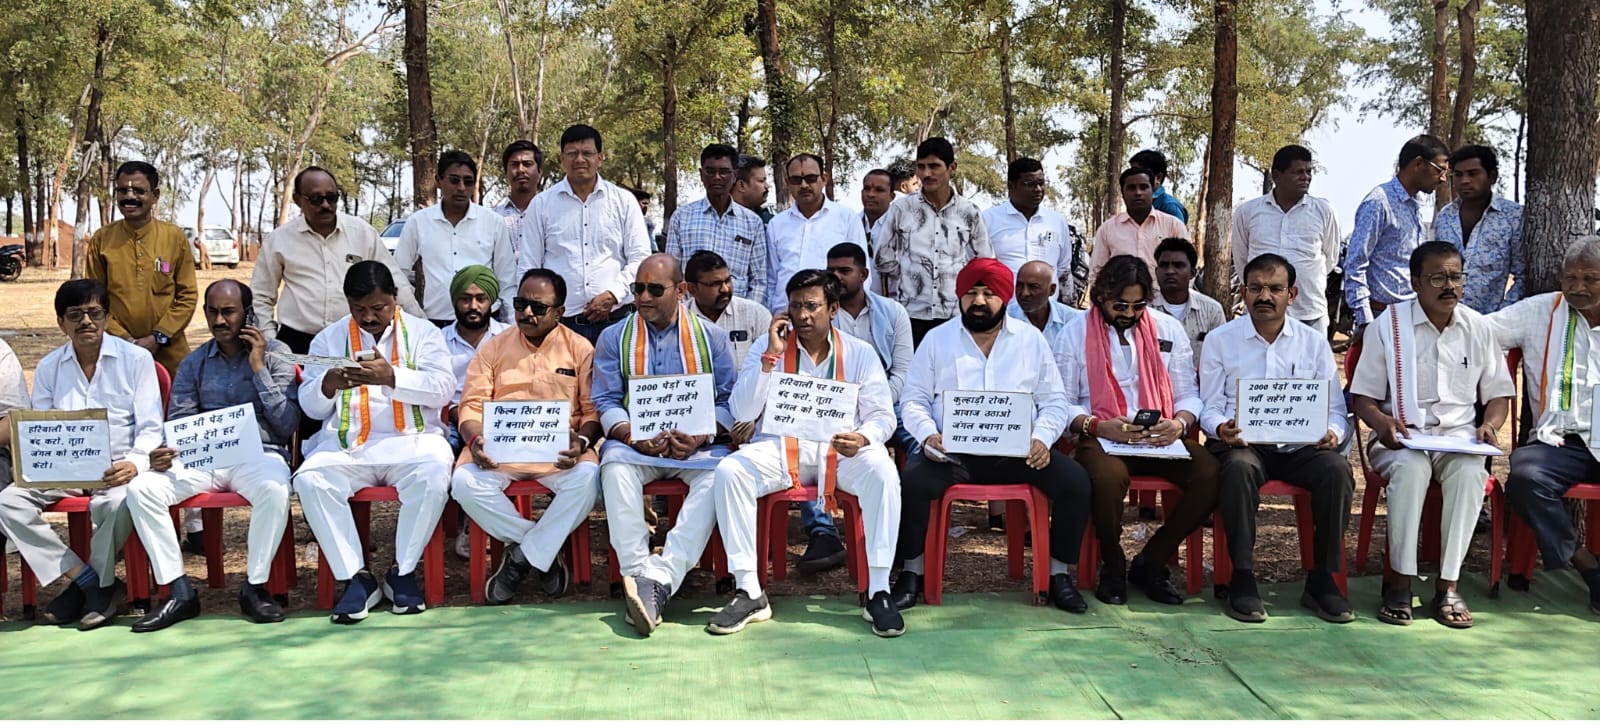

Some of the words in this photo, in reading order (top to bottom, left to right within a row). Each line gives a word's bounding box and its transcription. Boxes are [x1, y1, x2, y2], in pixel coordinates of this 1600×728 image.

[636, 384, 658, 392] 2000
[816, 383, 827, 391] पर
[656, 394, 672, 404] नहीं
[778, 390, 790, 399] बंद
[1249, 394, 1264, 403] नहीं
[1307, 394, 1317, 402] भी
[494, 406, 517, 415] फिल्म
[521, 406, 542, 415] सिटी
[776, 402, 798, 411] जंगल
[801, 406, 812, 414] को
[1283, 406, 1293, 414] तो
[638, 409, 660, 418] जंगल
[952, 409, 980, 417] आवाज
[985, 409, 1011, 418] उठाओ
[174, 423, 188, 432] एक
[194, 417, 204, 426] भी
[494, 420, 503, 429] में
[540, 420, 559, 429] पहले
[640, 423, 655, 432] नहीं
[952, 421, 975, 429] जंगल
[176, 433, 198, 445] कटने
[223, 426, 235, 435] हर
[493, 433, 517, 442] जंगल
[972, 435, 999, 443] संकल्प
[31, 449, 51, 457] जंगल
[180, 449, 197, 458] हाल
[216, 439, 240, 449] जंगल
